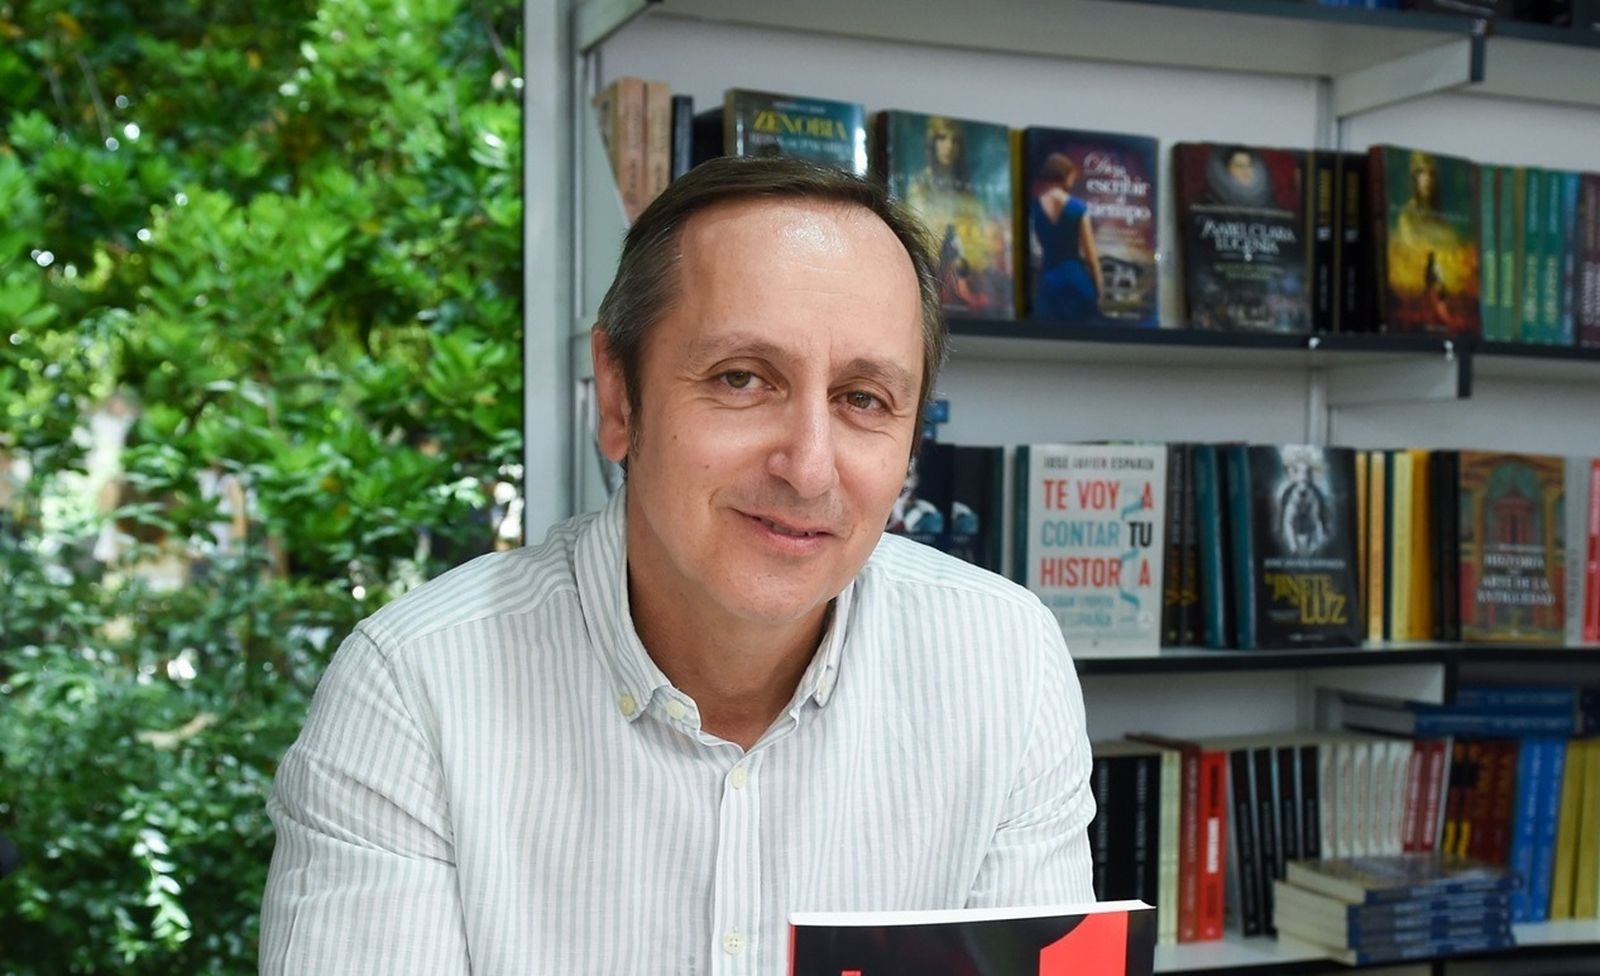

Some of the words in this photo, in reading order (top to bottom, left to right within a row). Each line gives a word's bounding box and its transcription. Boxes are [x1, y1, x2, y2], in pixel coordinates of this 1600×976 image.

[752, 109, 848, 140] ZENOBIA
[1043, 479, 1067, 511] TE
[1077, 479, 1120, 511] VOY
[1142, 480, 1154, 511] A
[1041, 520, 1120, 549] CONTAR
[1128, 520, 1153, 548] TU
[1301, 592, 1347, 625] LUZ
